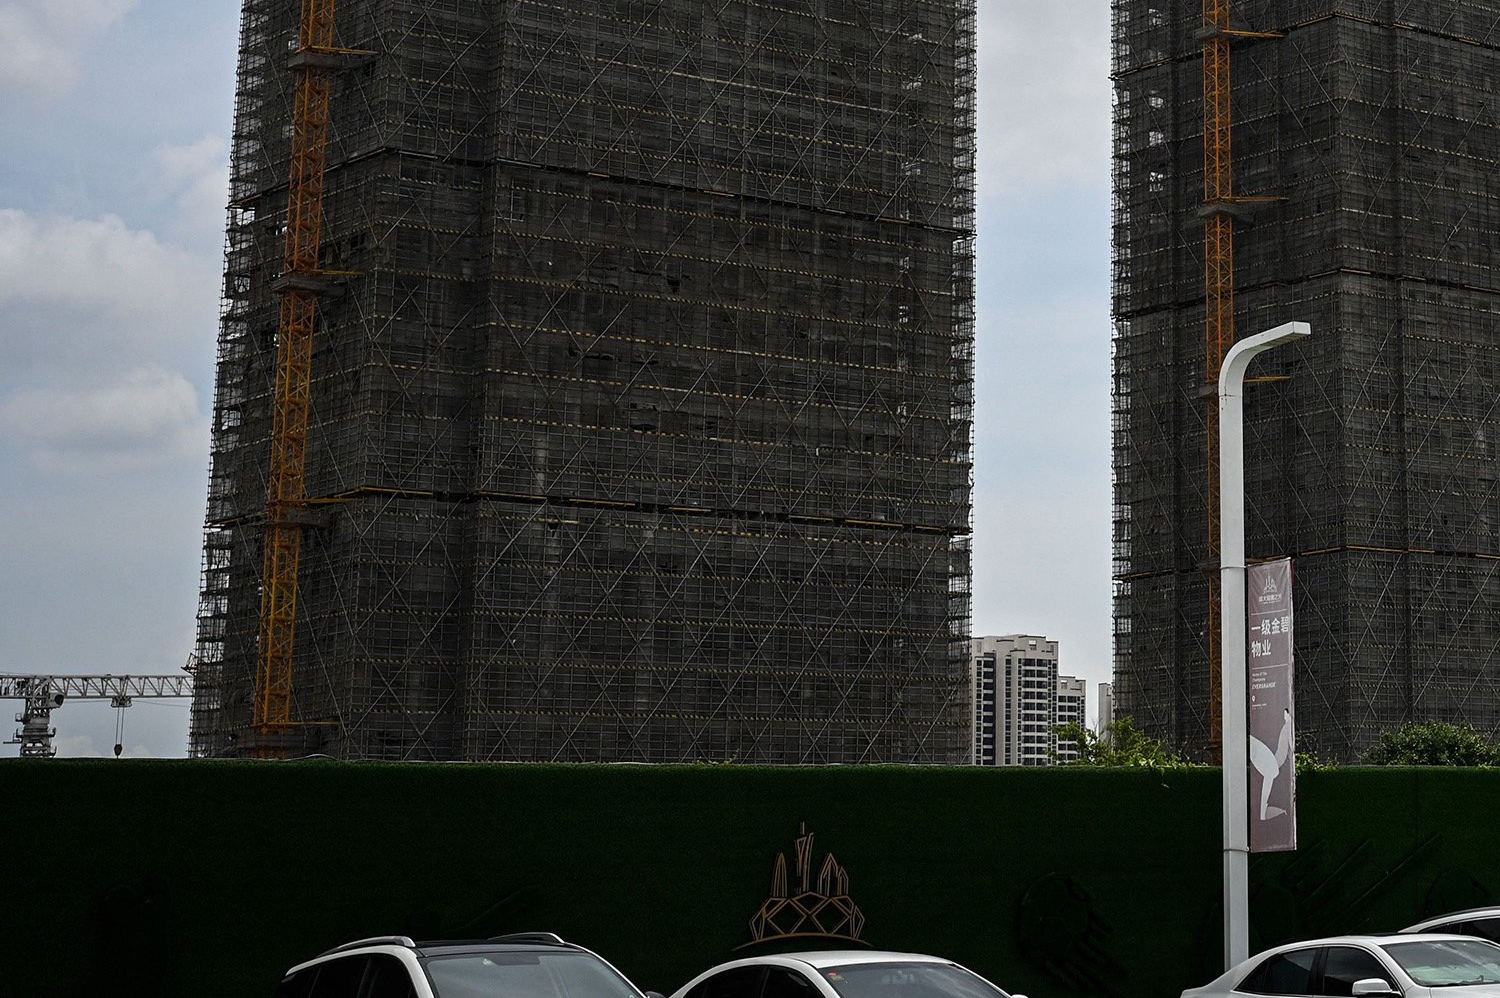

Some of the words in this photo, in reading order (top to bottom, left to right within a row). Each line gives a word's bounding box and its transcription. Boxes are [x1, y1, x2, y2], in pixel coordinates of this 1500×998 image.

[1251, 616, 1289, 635] 一级金碧
[1252, 639, 1271, 658] 物业
